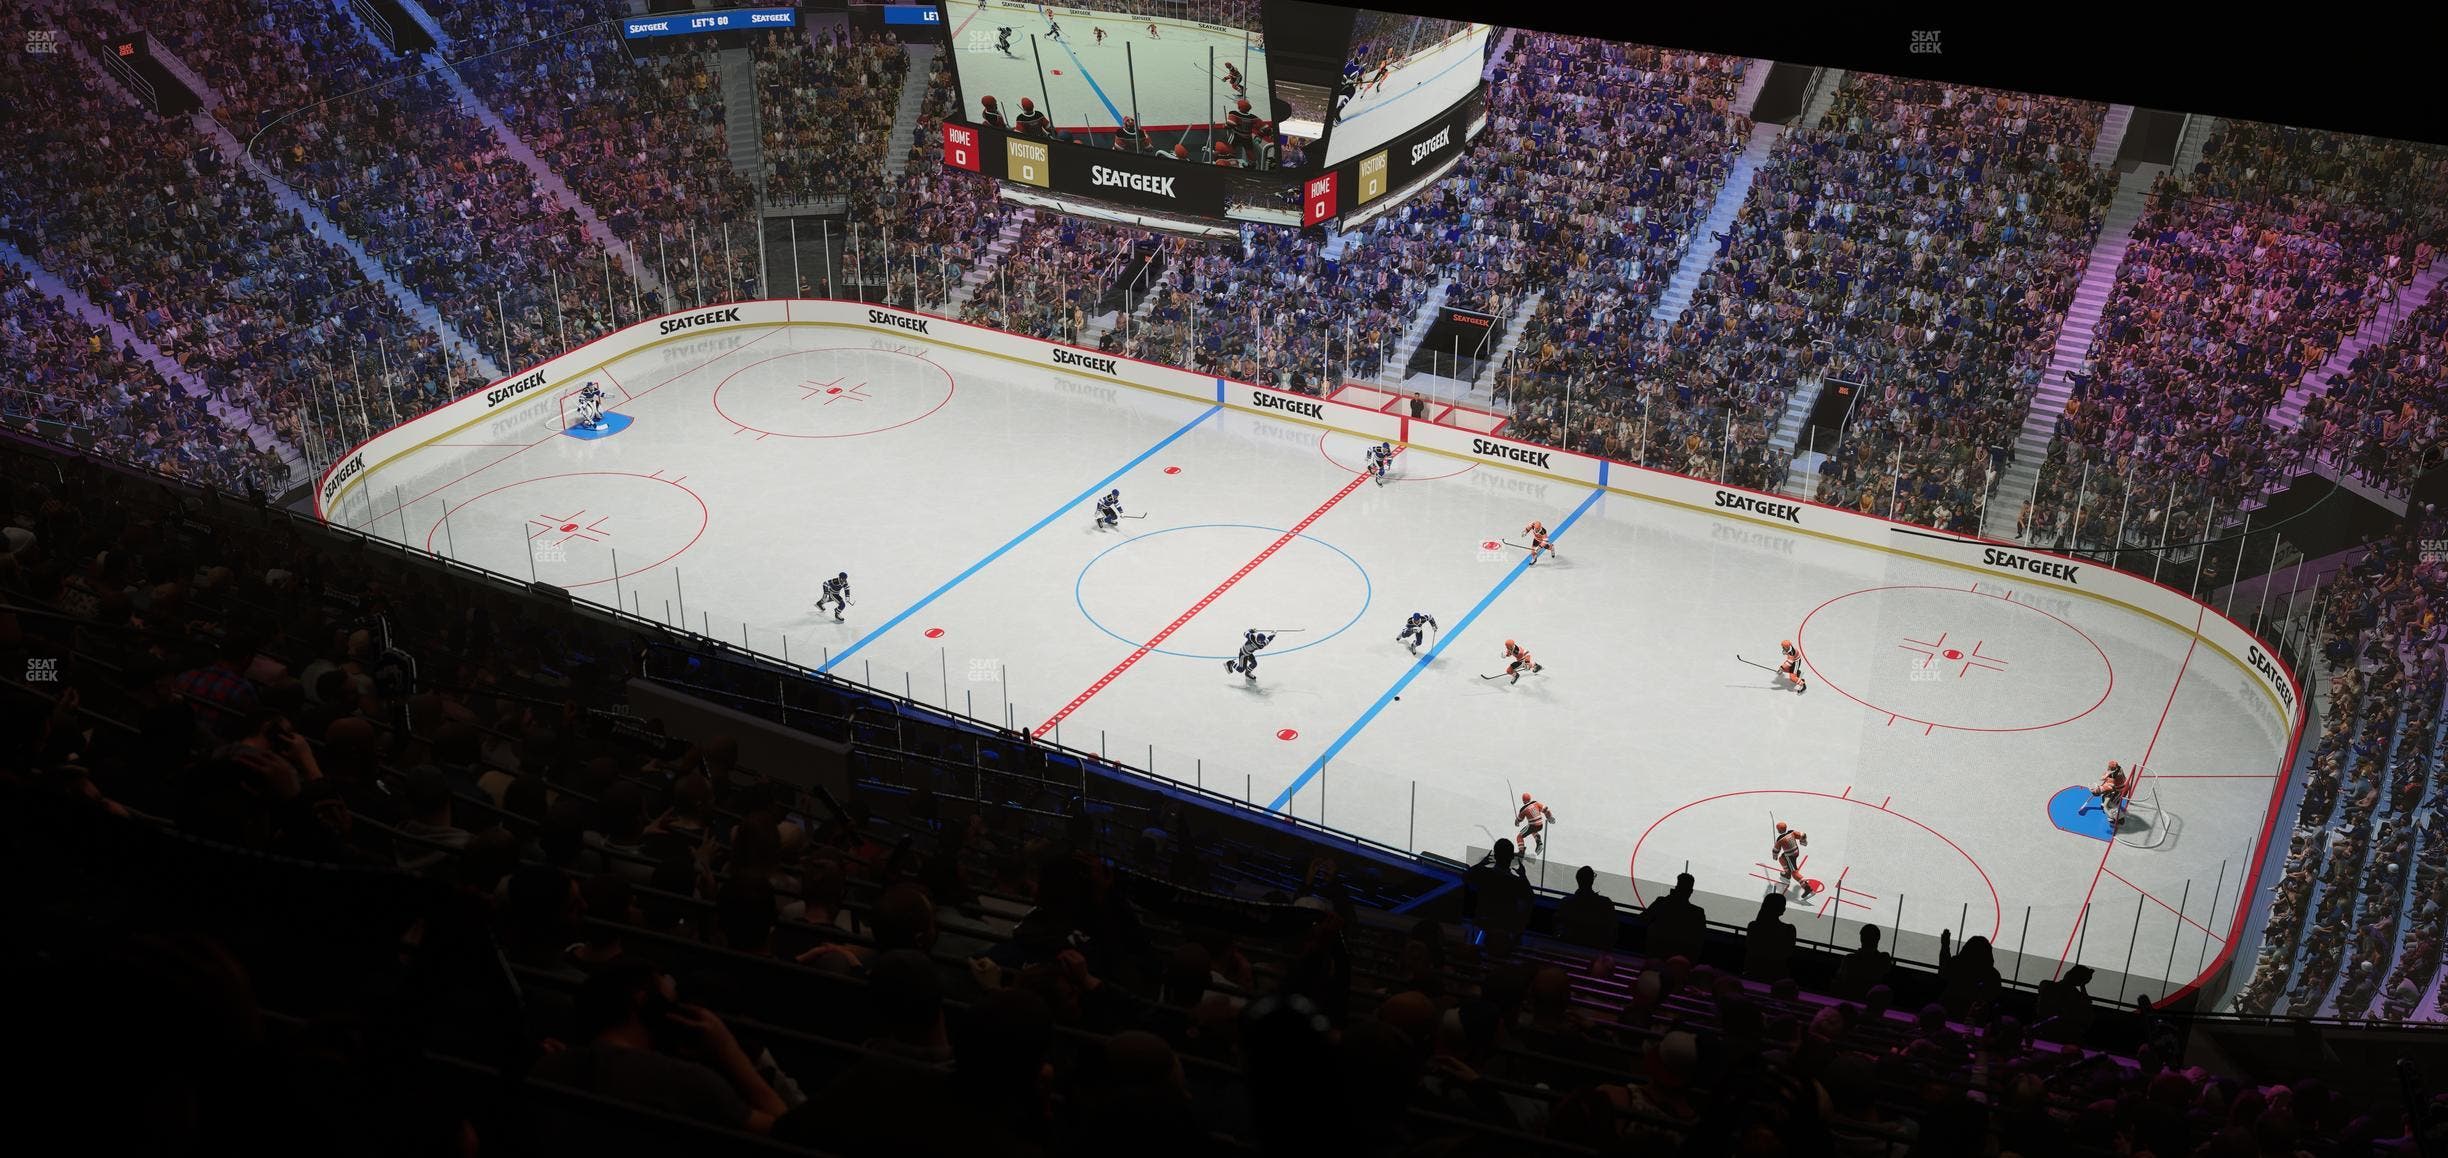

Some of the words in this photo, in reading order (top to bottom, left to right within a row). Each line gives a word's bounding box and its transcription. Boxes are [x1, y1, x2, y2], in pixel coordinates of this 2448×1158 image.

[629, 22, 669, 34] SEATGEEK
[691, 17, 715, 28] LET'S
[751, 13, 791, 23] SEATGEEK
[949, 127, 971, 147] HOME
[1411, 124, 1451, 166] SEATGEEK
[955, 149, 967, 165] 0
[1009, 141, 1046, 162] VISITORS
[1022, 165, 1034, 181] 0
[1361, 153, 1387, 178] VISITORS
[1091, 165, 1176, 198] SEATGEEK
[1311, 177, 1331, 199] HOME
[1368, 178, 1377, 195] 0
[1315, 201, 1325, 218] 0
[660, 307, 741, 336] SEATGEEK
[868, 309, 929, 334] SEATGEEK
[1452, 313, 1490, 328] SEATGEEK
[1052, 348, 1117, 376] SEATGEEK
[487, 369, 547, 408] SEATGEEK
[1252, 391, 1323, 420] SEATGEEK
[1472, 438, 1550, 470] SEATGEEK
[325, 452, 366, 504] SEATGEEK
[1714, 490, 1800, 524] SEATGEEK
[1983, 547, 2080, 584] SEATGEEK
[2247, 645, 2294, 715] SEATGEEK
